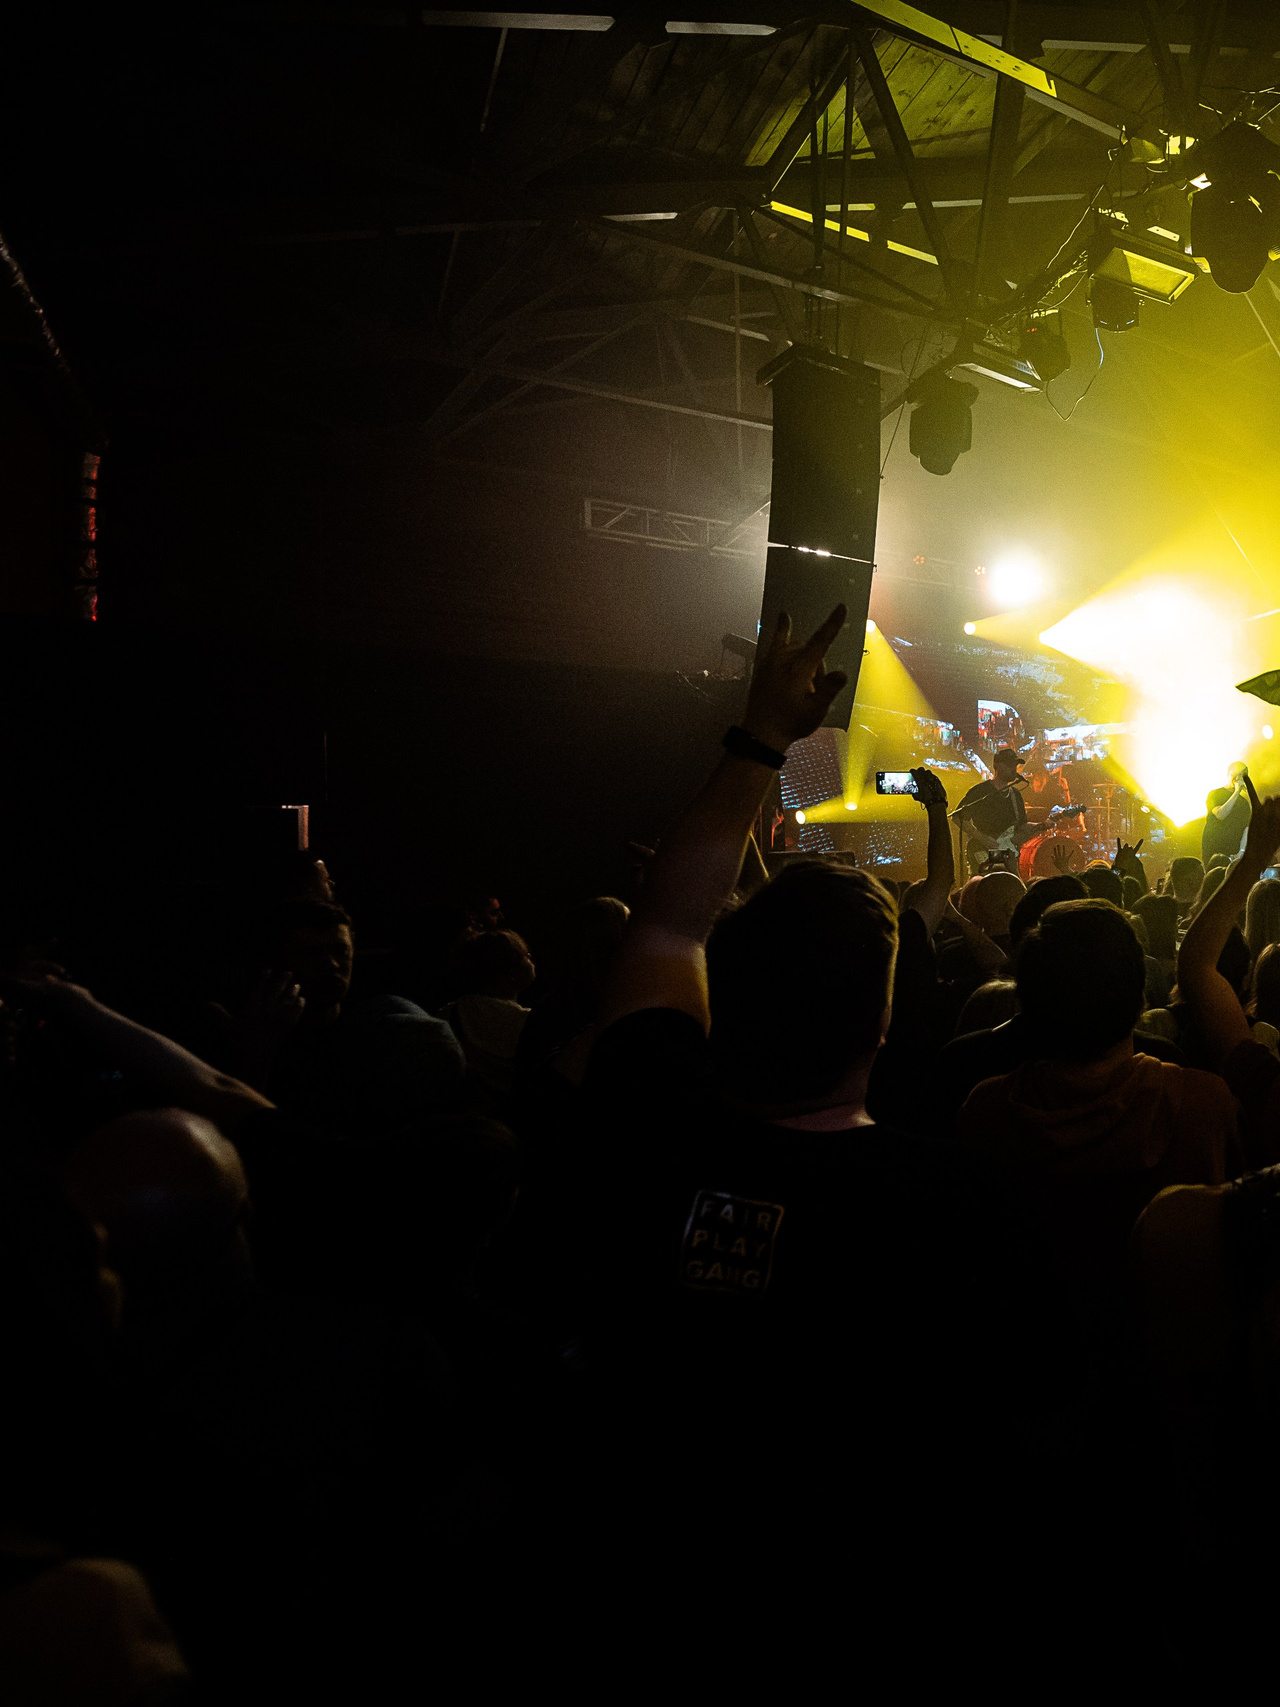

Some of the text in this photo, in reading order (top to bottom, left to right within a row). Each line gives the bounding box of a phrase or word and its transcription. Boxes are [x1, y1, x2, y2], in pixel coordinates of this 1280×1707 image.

[700, 1200, 773, 1232] FAIR
[691, 1227, 766, 1259] PLAY
[686, 1259, 761, 1289] GANG
